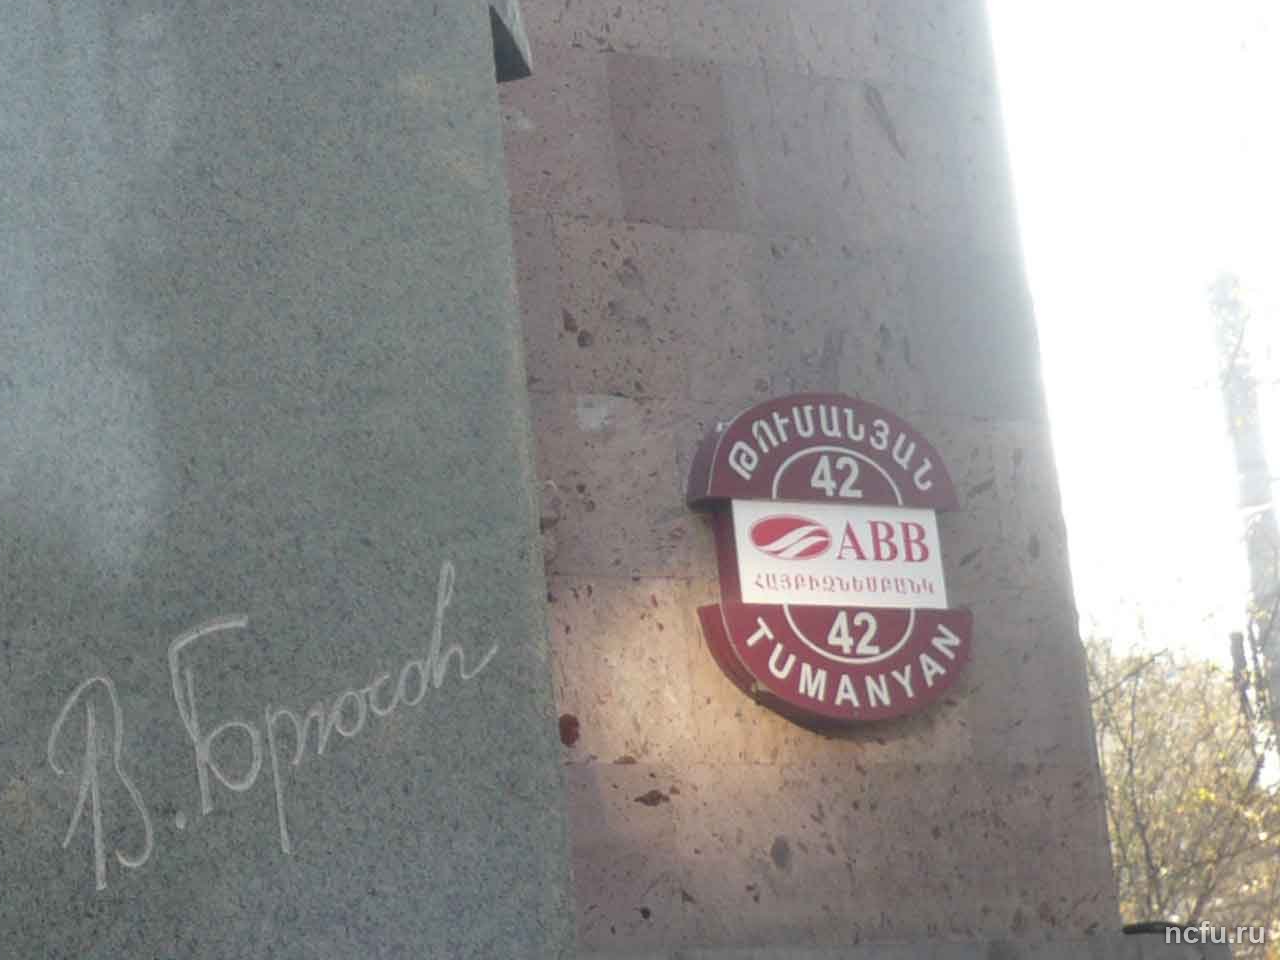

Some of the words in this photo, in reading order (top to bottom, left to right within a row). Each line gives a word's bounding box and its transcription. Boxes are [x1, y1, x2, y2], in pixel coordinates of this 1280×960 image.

[728, 404, 933, 492] ԹՈՒՄԱՆՅԱՆ
[810, 455, 863, 498] 42
[836, 520, 930, 563] ABB
[827, 610, 881, 656] 42
[746, 616, 961, 708] TUMANYAN
